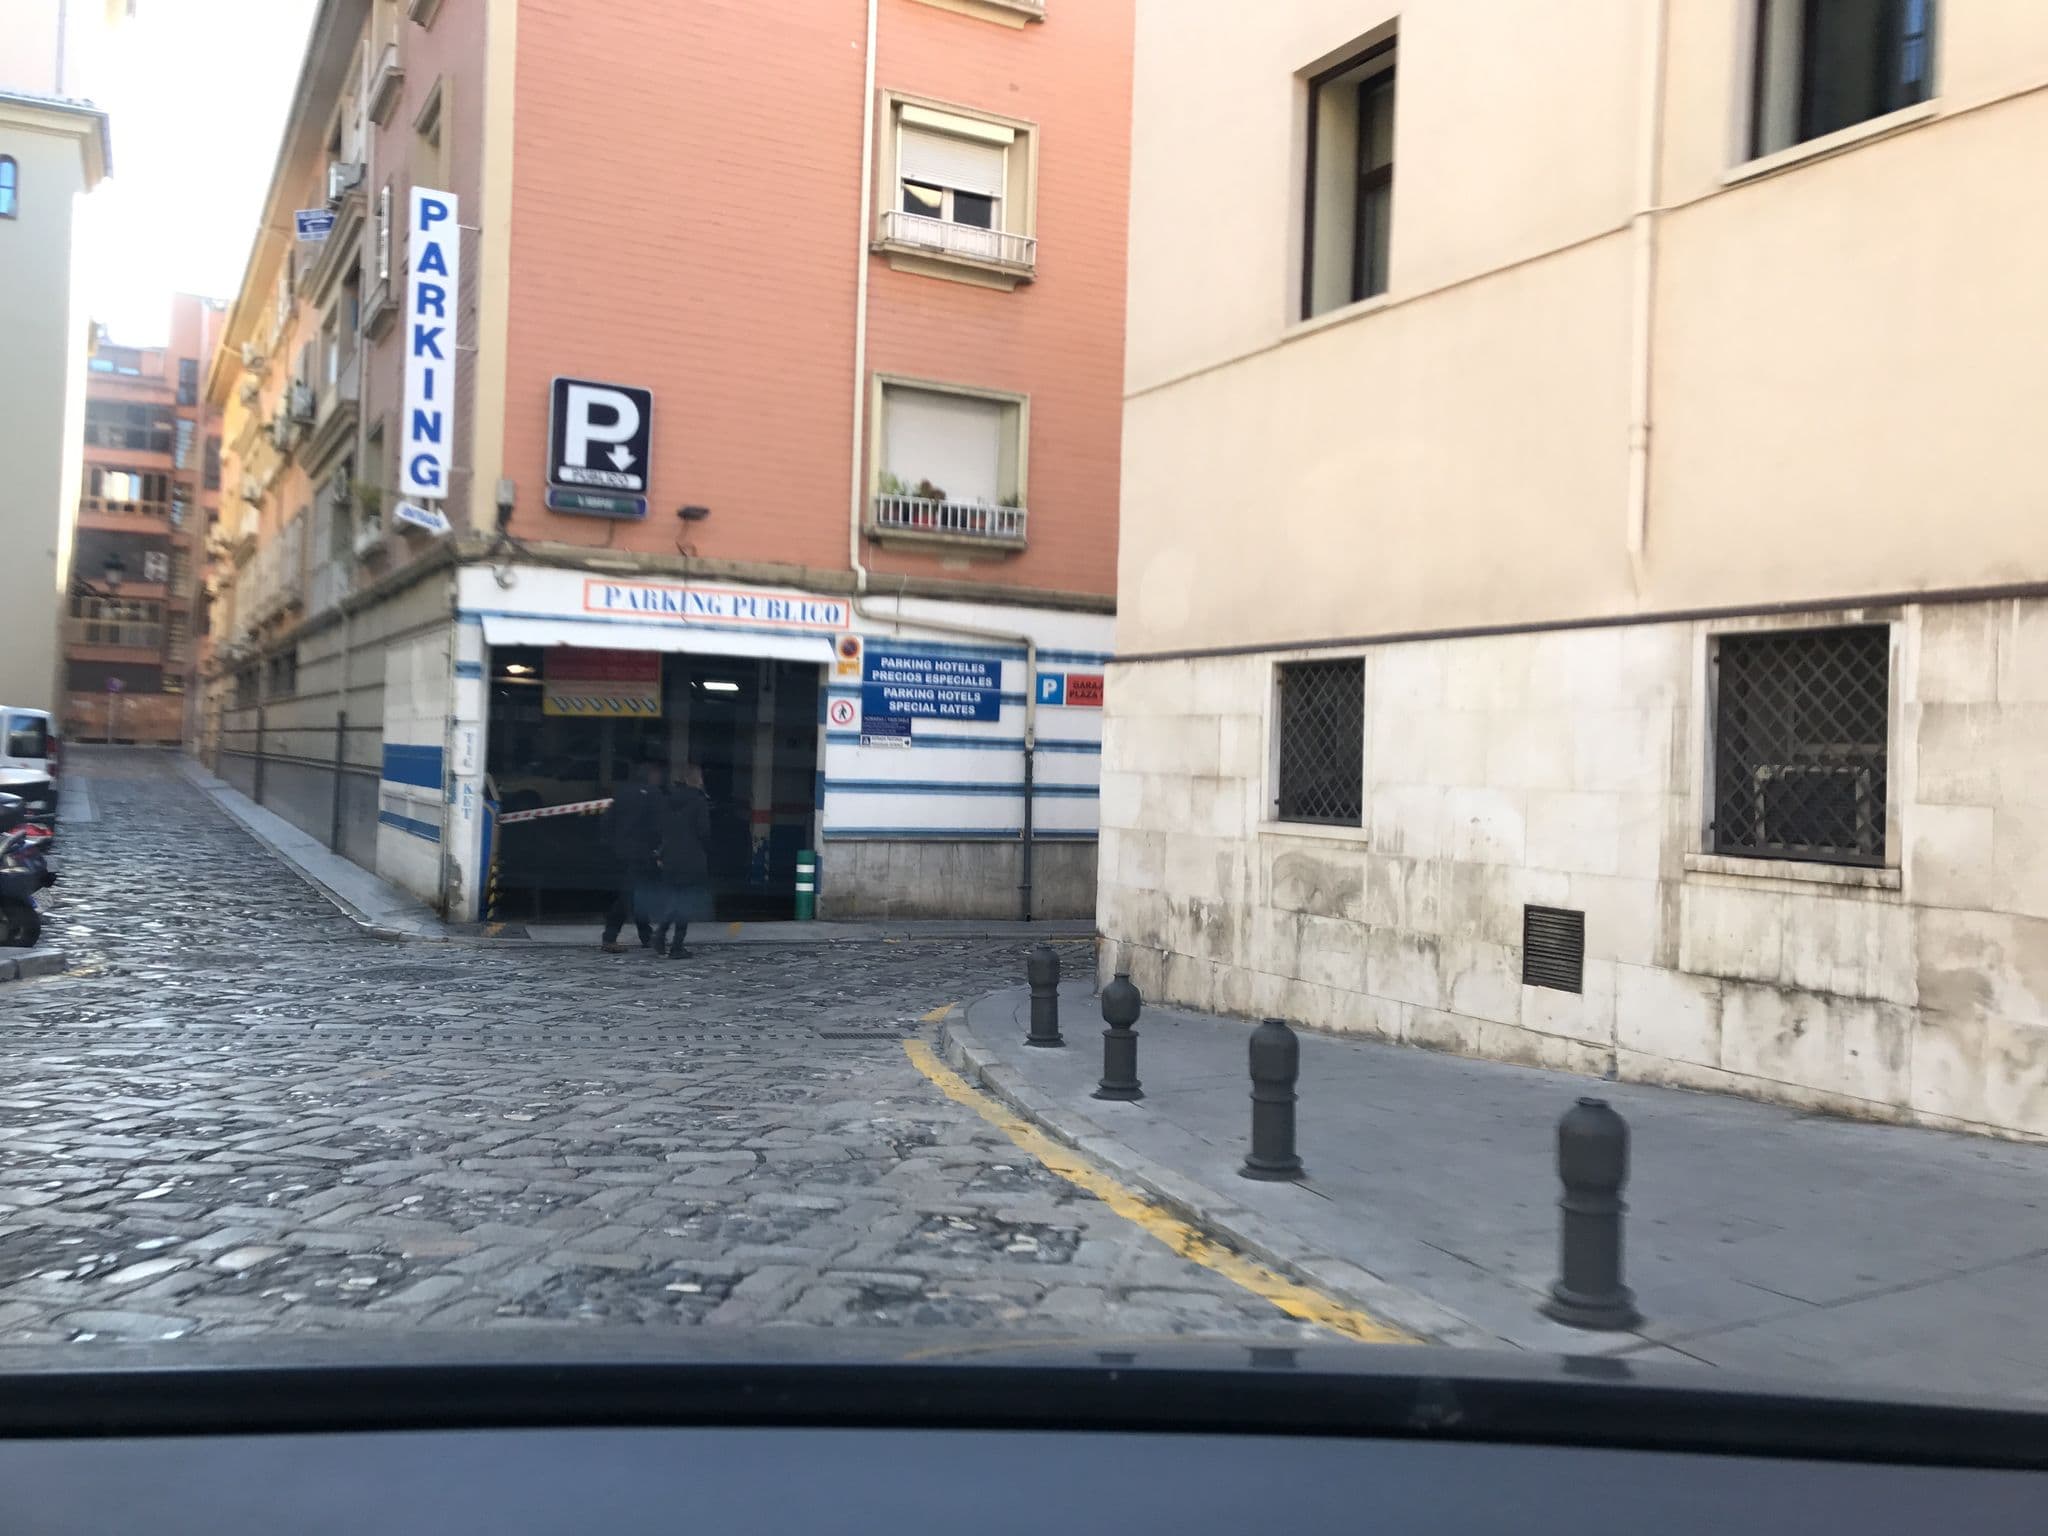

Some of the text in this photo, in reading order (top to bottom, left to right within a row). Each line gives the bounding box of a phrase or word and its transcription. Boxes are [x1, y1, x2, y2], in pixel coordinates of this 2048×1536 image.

[410, 198, 448, 488] PARKING
[564, 384, 640, 467] P
[603, 586, 840, 624] PARKING PUBLICO
[880, 657, 985, 673] PARKING HOTELES
[872, 670, 993, 687] PRECIOS ESPECIALES
[883, 687, 981, 702] PARKING HOTELS
[1042, 678, 1058, 699] P
[889, 701, 976, 715] SPECIAL RATES
